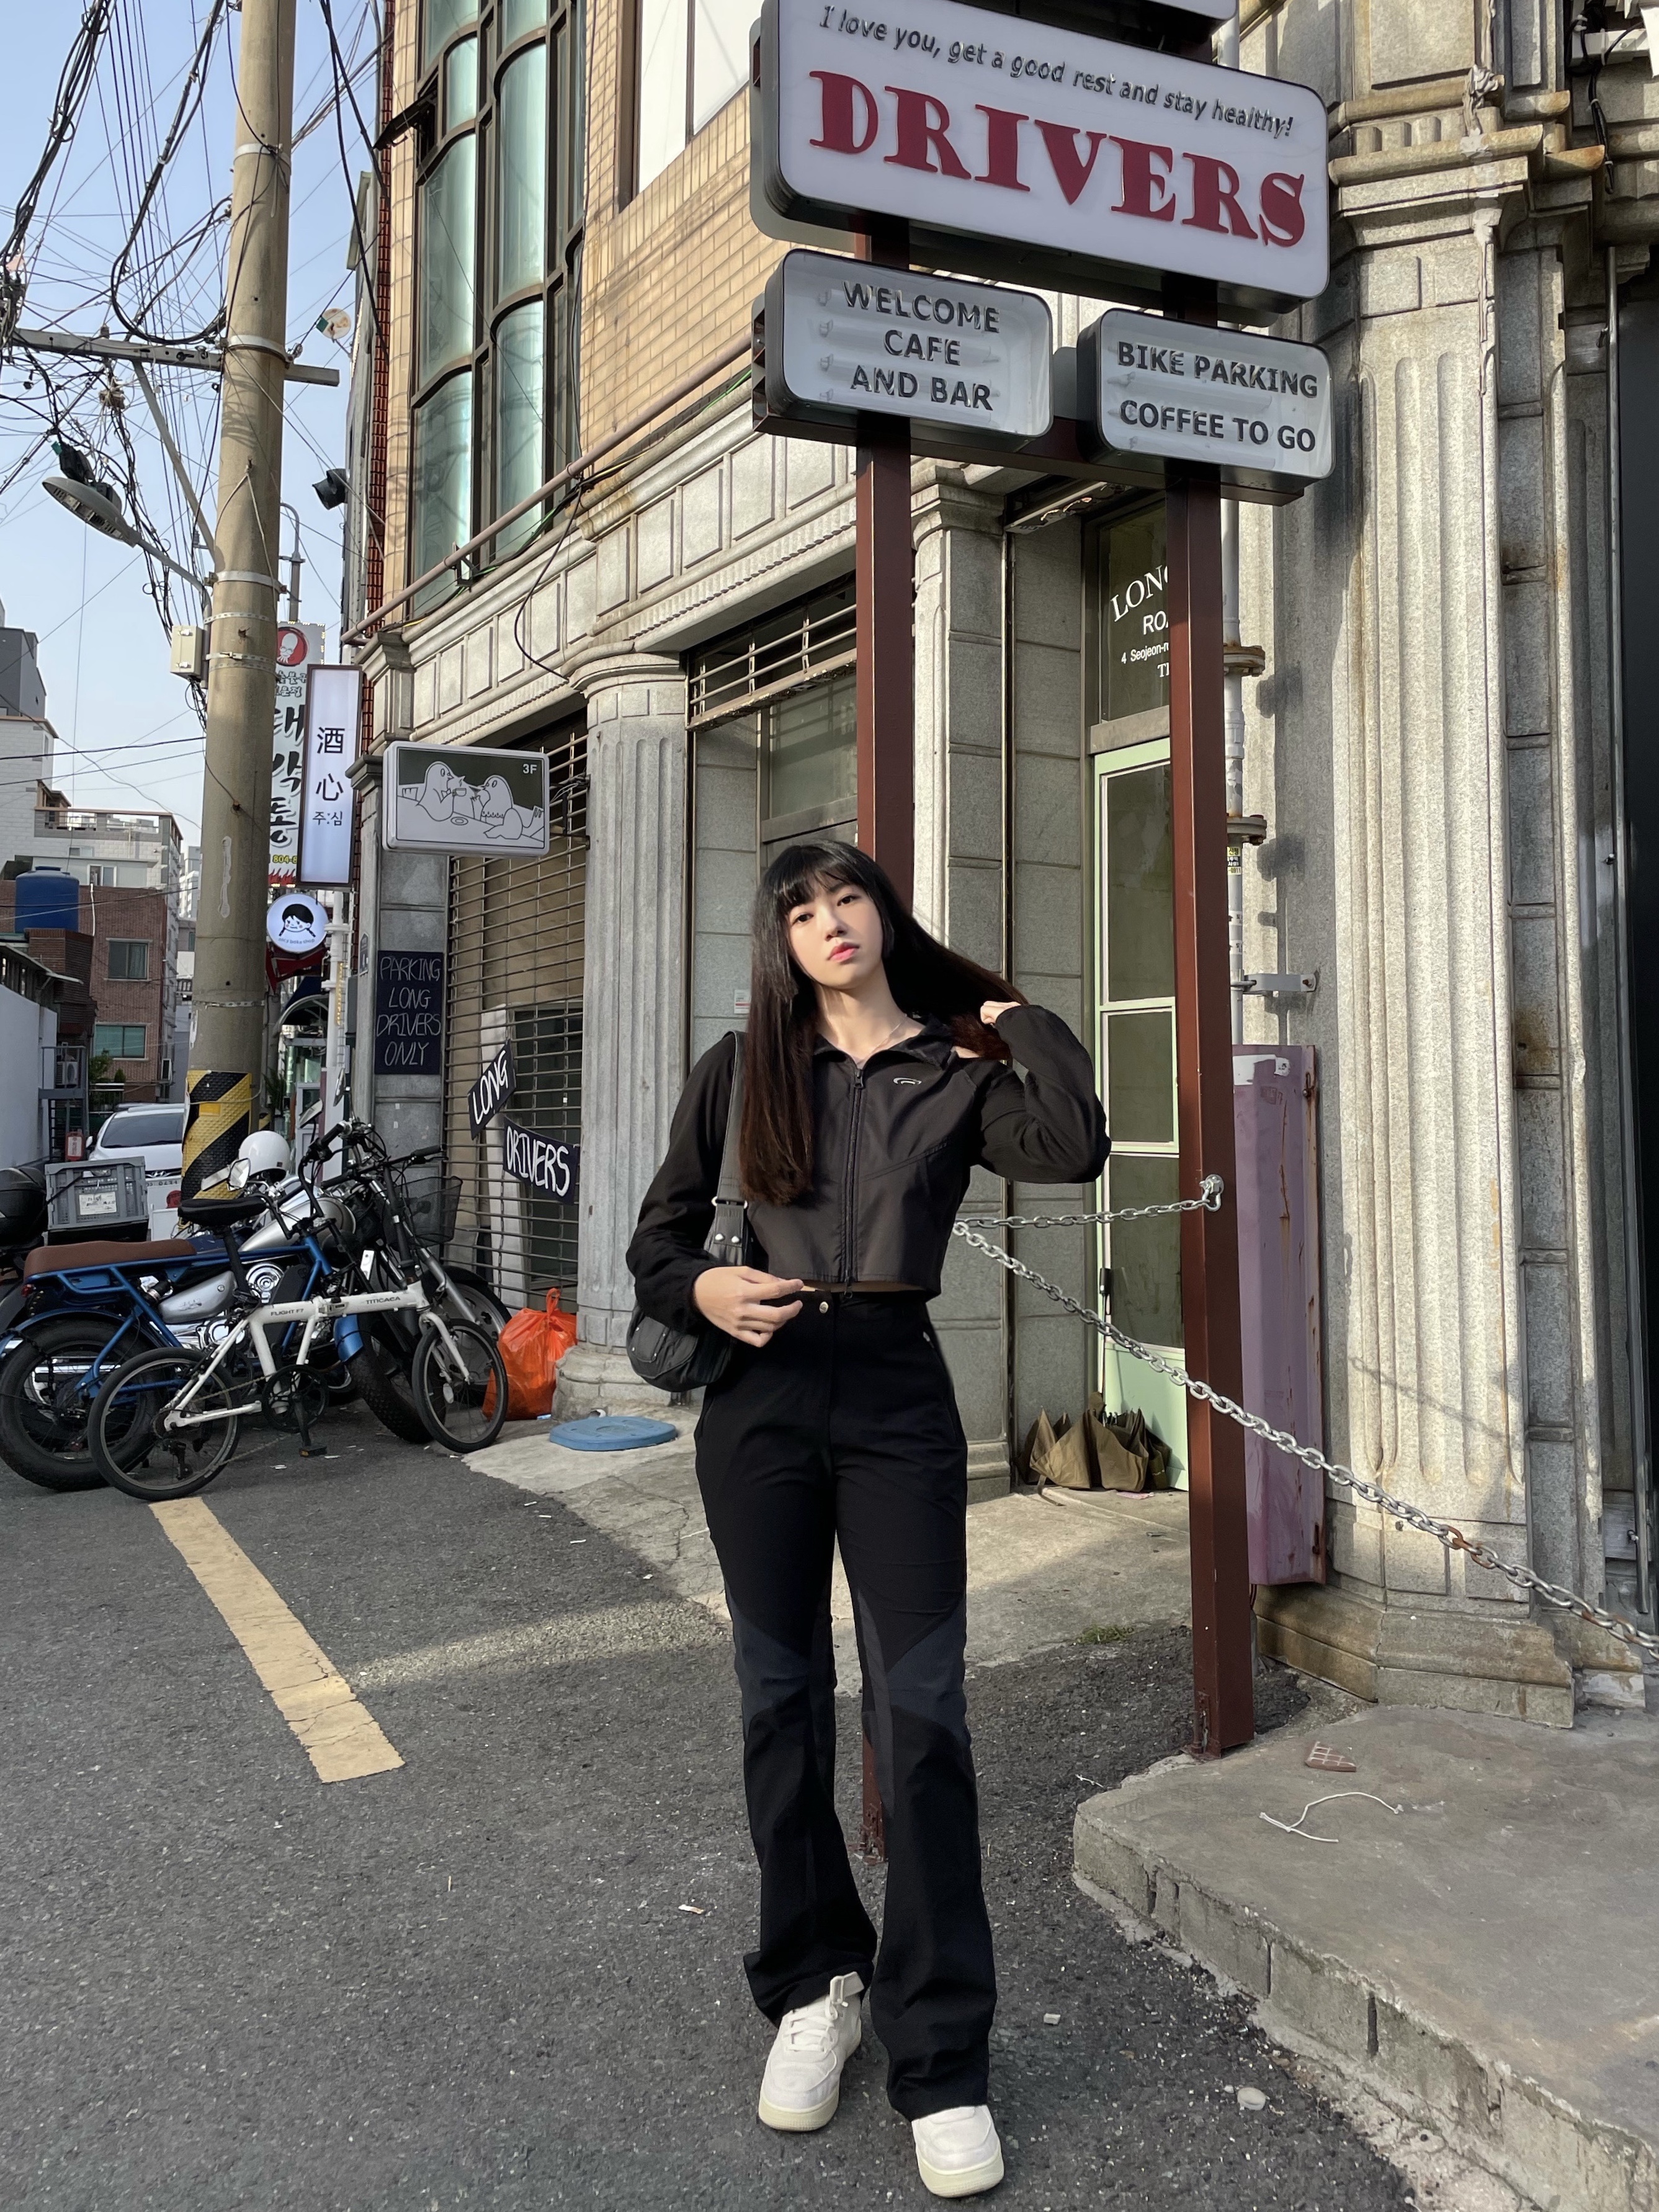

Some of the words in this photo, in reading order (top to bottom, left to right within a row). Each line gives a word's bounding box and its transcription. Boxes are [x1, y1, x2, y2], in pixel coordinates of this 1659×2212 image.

[819, 5, 835, 29] I
[838, 9, 888, 41] love
[893, 27, 941, 59] you,
[947, 40, 988, 64] get
[991, 50, 1005, 69] a
[1009, 56, 1066, 83] good
[1072, 69, 1116, 96] rest
[1119, 80, 1160, 105] and
[1163, 90, 1208, 121] stay
[1211, 98, 1294, 140] healthy!
[809, 69, 1306, 248] DRIVERS
[843, 280, 1000, 334] WELCOME
[884, 329, 961, 366] CAFE
[850, 365, 920, 398] AND
[931, 376, 994, 411] BAR
[1117, 341, 1185, 376] BIKE
[1193, 354, 1318, 399] PARKING
[1119, 400, 1225, 439] COFFEE
[1232, 417, 1269, 445] TO
[1277, 425, 1316, 452] GO
[1143, 610, 1169, 635] RO
[1120, 652, 1127, 665] 4
[522, 763, 538, 774] 3F
[380, 956, 442, 982] PARKING
[388, 987, 432, 1010] LONG
[377, 1012, 441, 1037] DRIVERS
[384, 1041, 430, 1067] ONLY
[472, 1050, 509, 1125] LONG
[506, 1126, 571, 1197] DRIVERS
[365, 1296, 401, 1305] TITICACA
